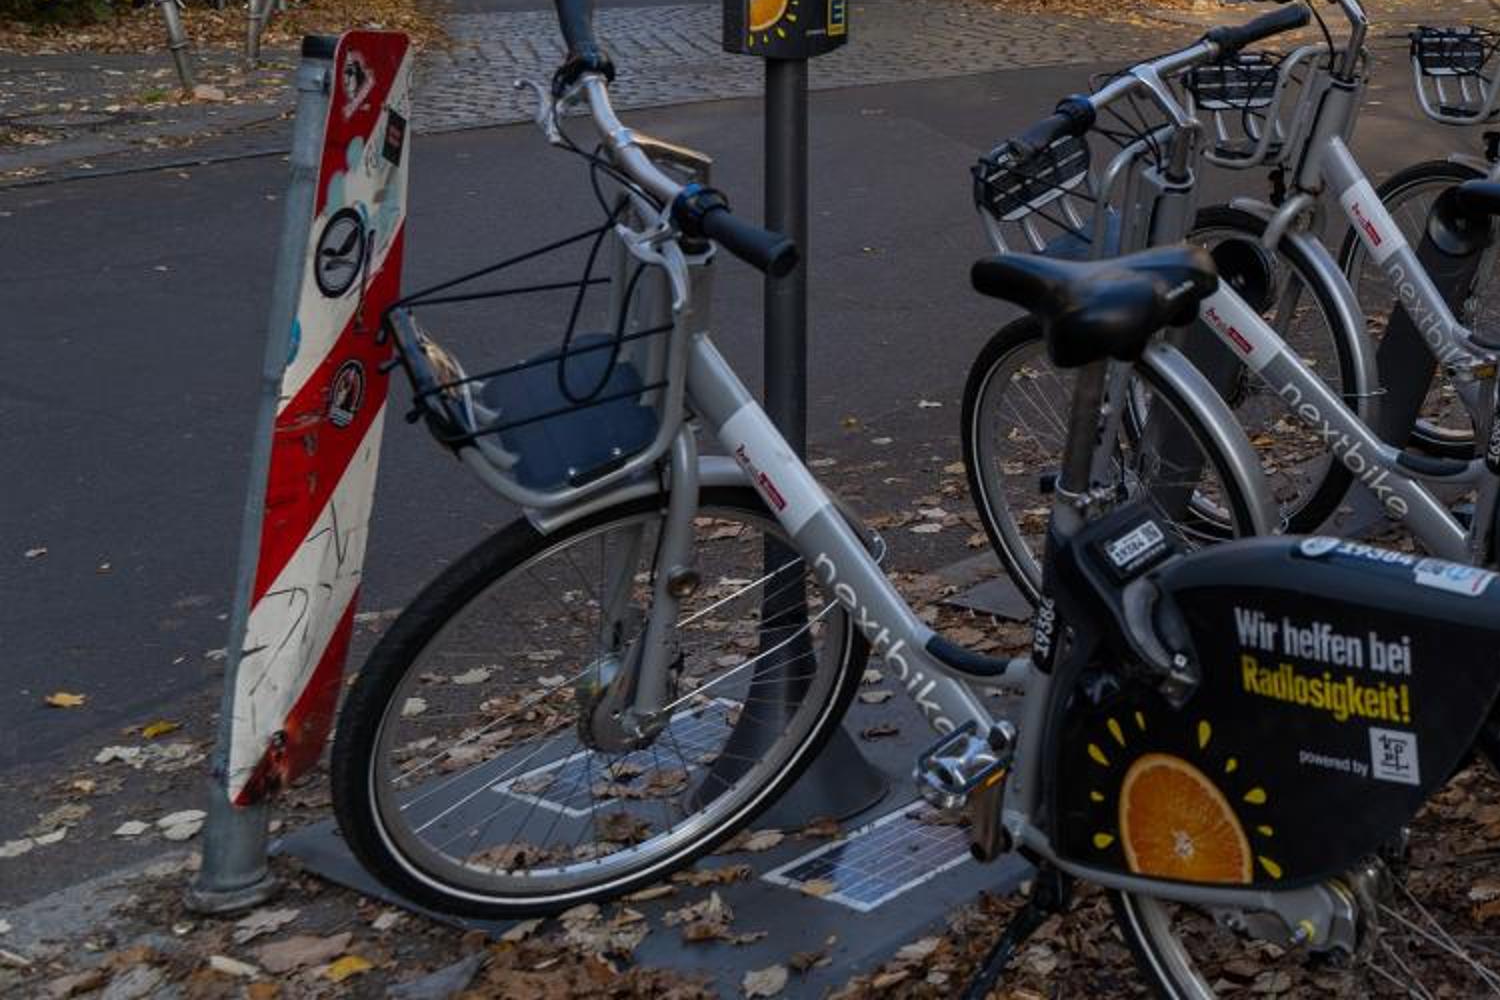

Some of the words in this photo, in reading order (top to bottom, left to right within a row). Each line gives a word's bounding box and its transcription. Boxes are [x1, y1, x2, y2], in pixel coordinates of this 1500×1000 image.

[1281, 382, 1410, 519] nextbike
[1234, 606, 1278, 651] Wir
[1282, 616, 1363, 669] helfen
[1368, 631, 1412, 676] bei
[1241, 654, 1411, 723] Radlosigkeit!
[1299, 750, 1351, 771] powered
[1352, 759, 1369, 778] by
